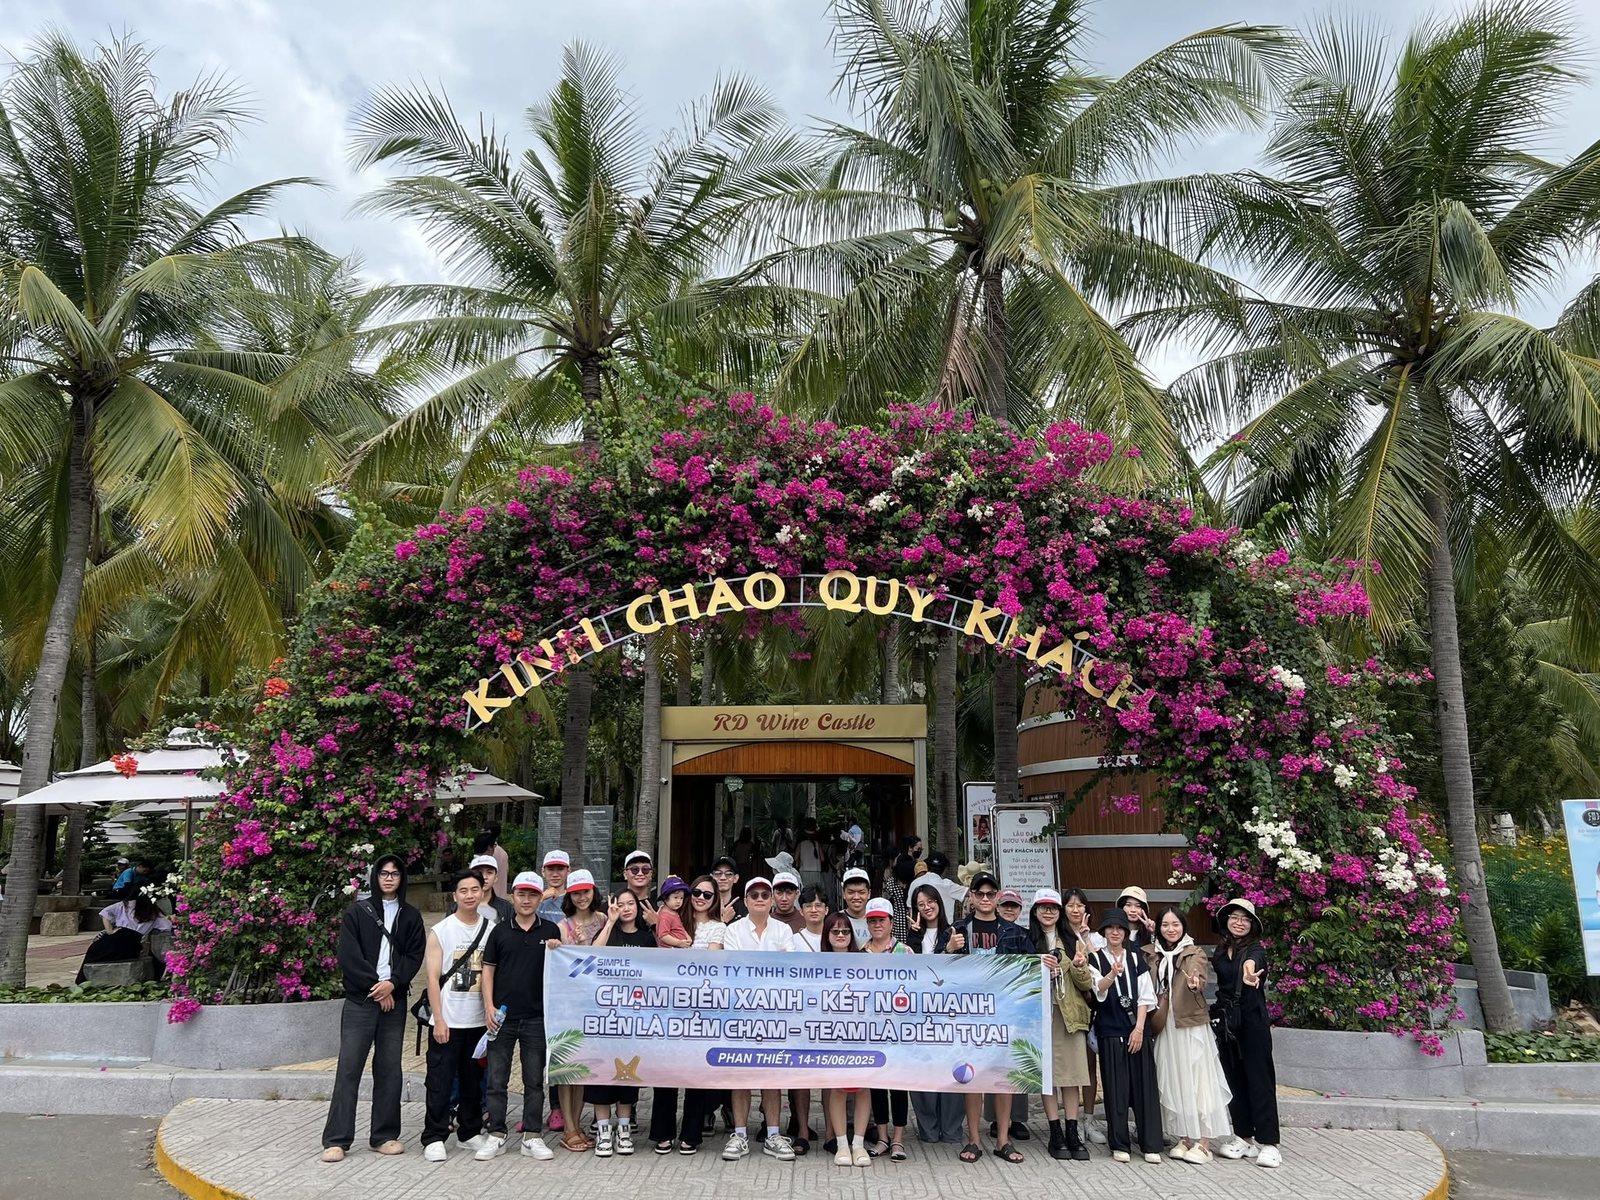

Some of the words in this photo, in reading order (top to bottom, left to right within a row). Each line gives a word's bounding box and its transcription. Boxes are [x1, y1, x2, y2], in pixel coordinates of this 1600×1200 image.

[713, 713, 749, 732] RD
[756, 713, 810, 732] Wine
[817, 712, 876, 731] Castle
[597, 958, 631, 967] SIMPLE
[677, 962, 719, 977] CÔNG
[723, 965, 741, 977] TY
[746, 966, 785, 978] TNHH
[789, 967, 842, 980] SIMPLE
[846, 968, 918, 981] SOLUTION
[596, 968, 643, 978] SOLUTION
[595, 985, 669, 1010] CHẠM
[673, 979, 731, 1010] BIỂN
[734, 988, 804, 1011] XANH
[821, 982, 871, 1013] KẾT
[874, 984, 917, 1014] NỐI
[922, 992, 996, 1017] MẠNH
[583, 1009, 633, 1037] BIỂN
[635, 1015, 665, 1038] LÀ
[667, 1011, 722, 1039] ĐIỂM
[724, 1019, 787, 1042] CHẠM
[804, 1020, 867, 1042] TEAM
[869, 1018, 899, 1043] LÀ
[900, 1015, 954, 1044] ĐIỂM
[717, 1052, 752, 1064] PHAN
[756, 1049, 794, 1066] THIẾT,
[797, 1054, 875, 1066] 14-15/06/2025
